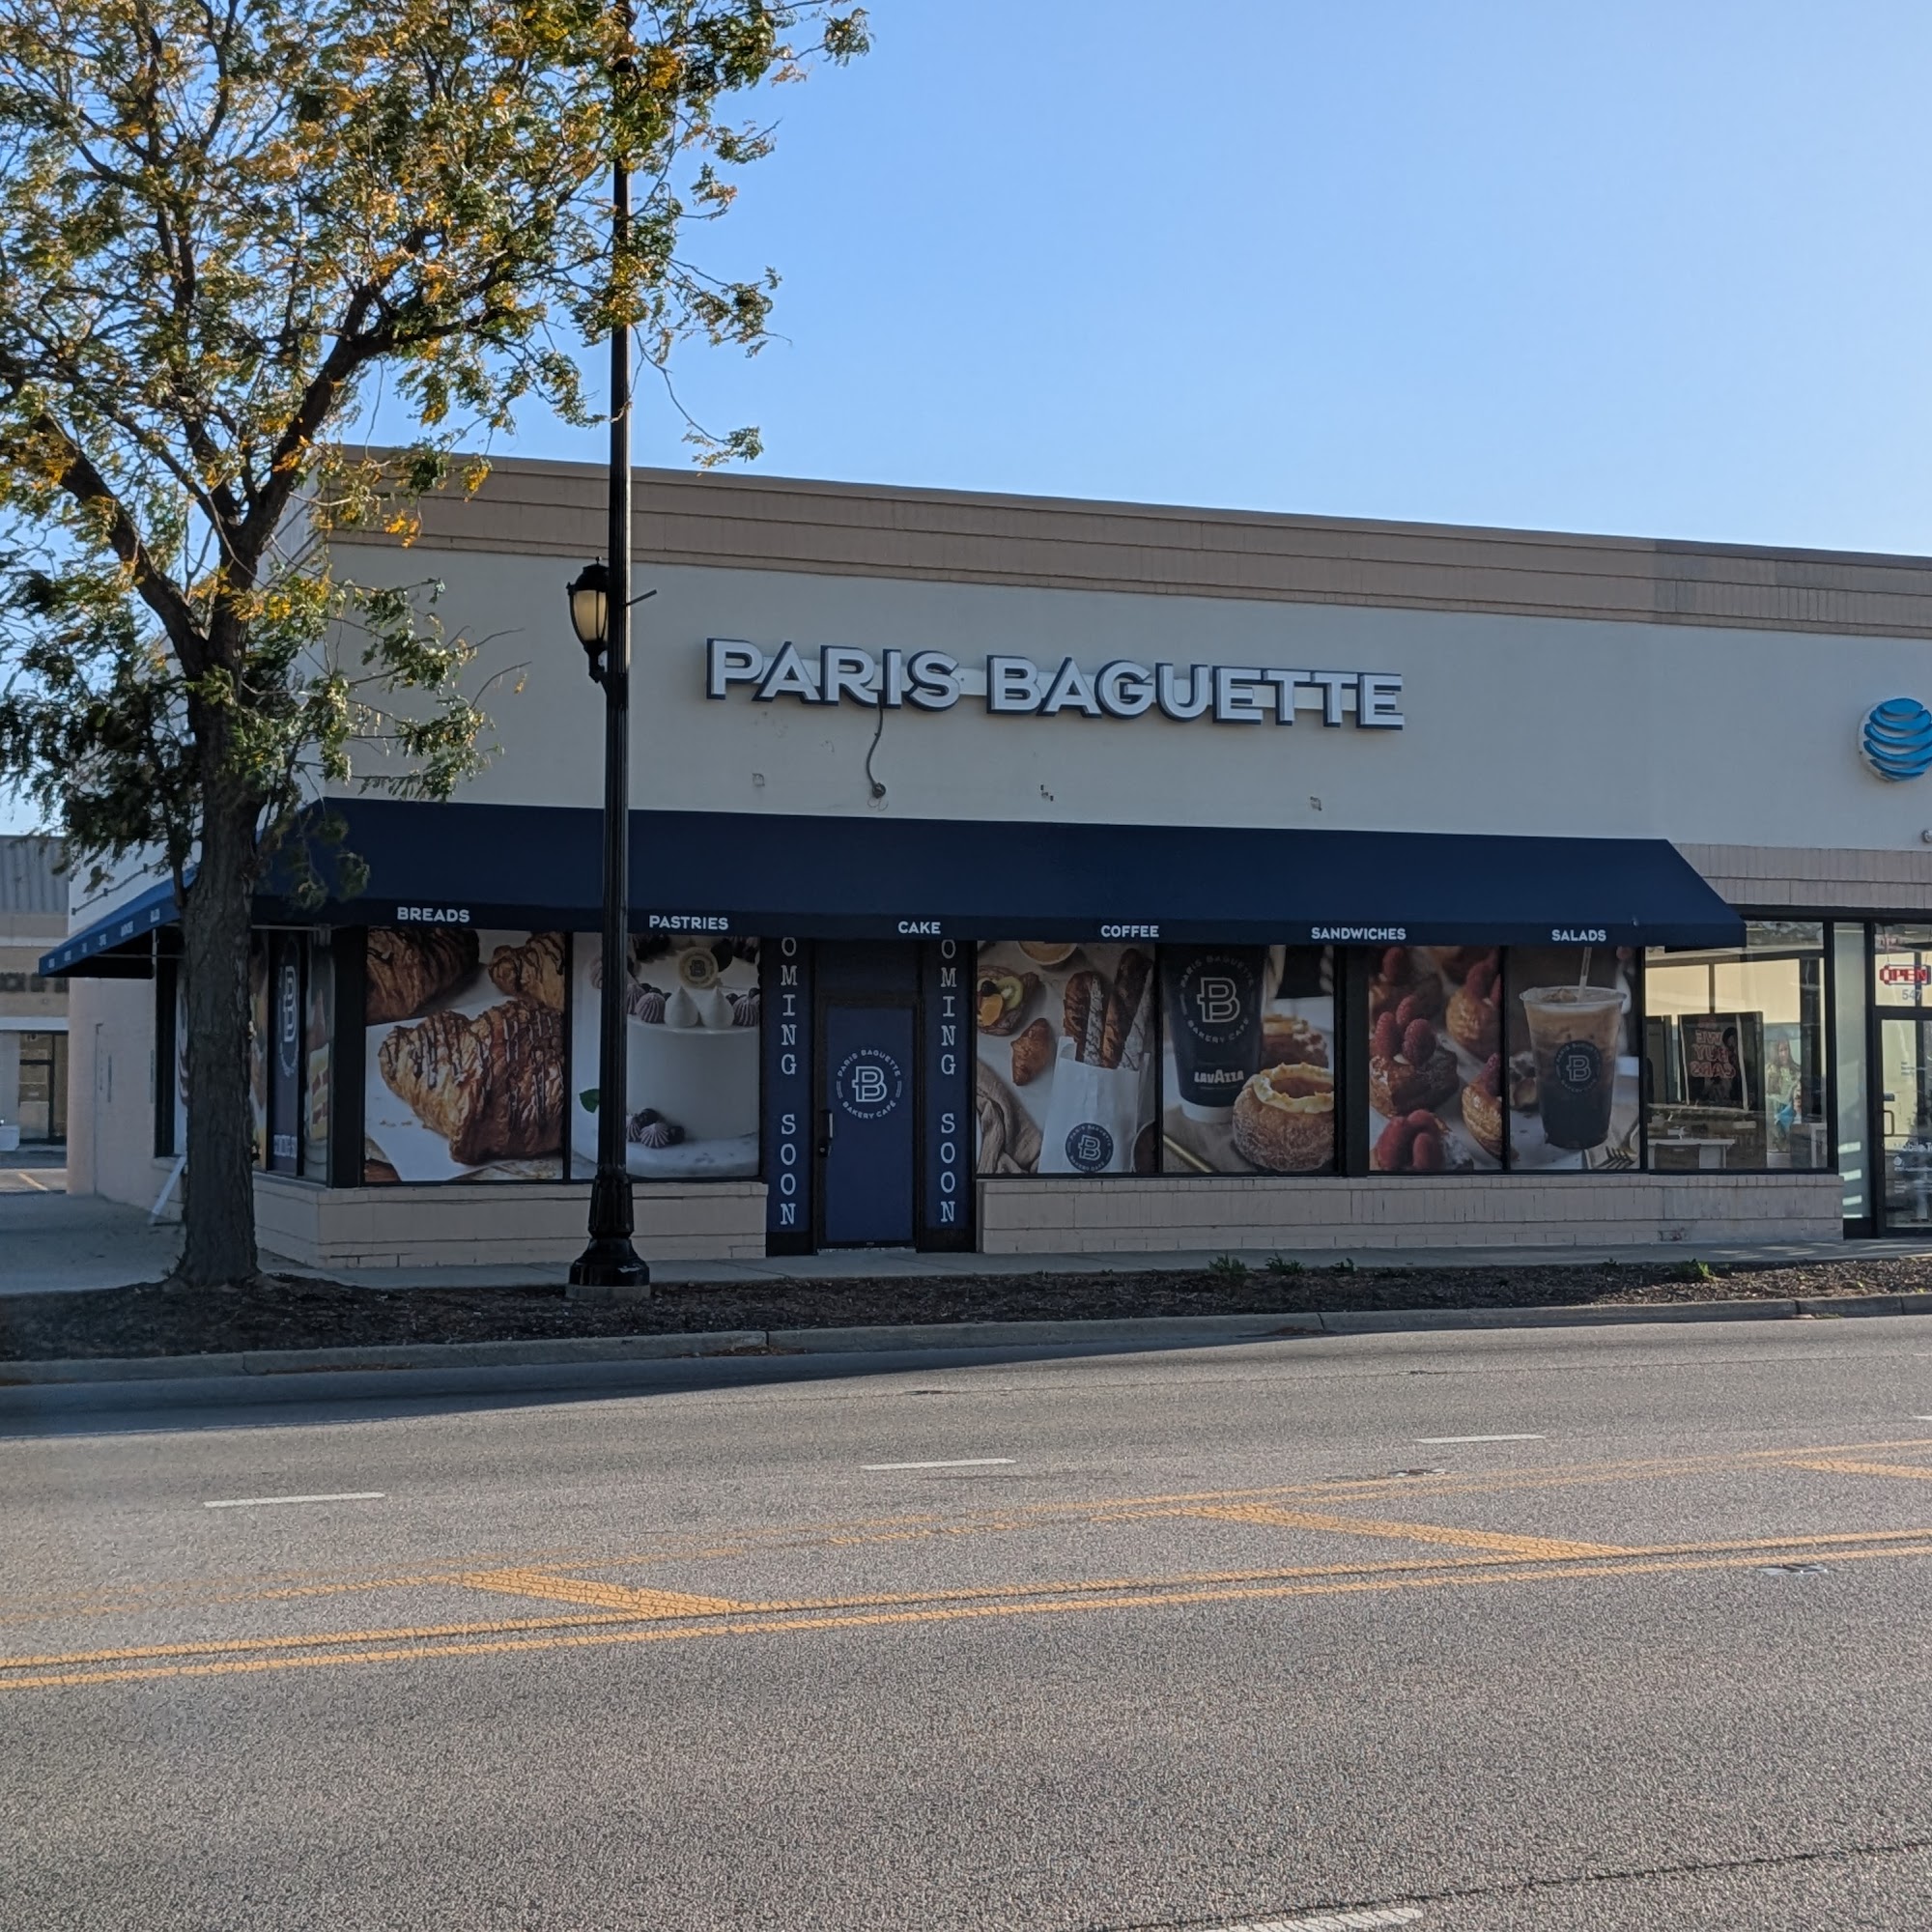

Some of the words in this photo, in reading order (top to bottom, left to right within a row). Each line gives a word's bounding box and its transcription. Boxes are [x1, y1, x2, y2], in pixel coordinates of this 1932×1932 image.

[706, 638, 961, 711] PARIS
[985, 654, 1406, 731] BAGUETTE
[396, 906, 470, 923] BREADS
[648, 915, 729, 930] PASTRIES
[897, 921, 941, 934] CAKE
[1100, 924, 1160, 938] COFFEE
[1311, 926, 1406, 940] SANDWICHES
[1551, 928, 1606, 942] SALADS
[1879, 964, 1928, 985] OPEN
[780, 936, 798, 1075] OMING
[940, 938, 957, 1075] OMING
[837, 1052, 859, 1078] PARIS
[861, 1049, 901, 1077] BAGUETTE
[842, 1100, 874, 1120] BAKERY
[780, 1113, 796, 1225] SOON
[940, 1112, 956, 1223] SOON
